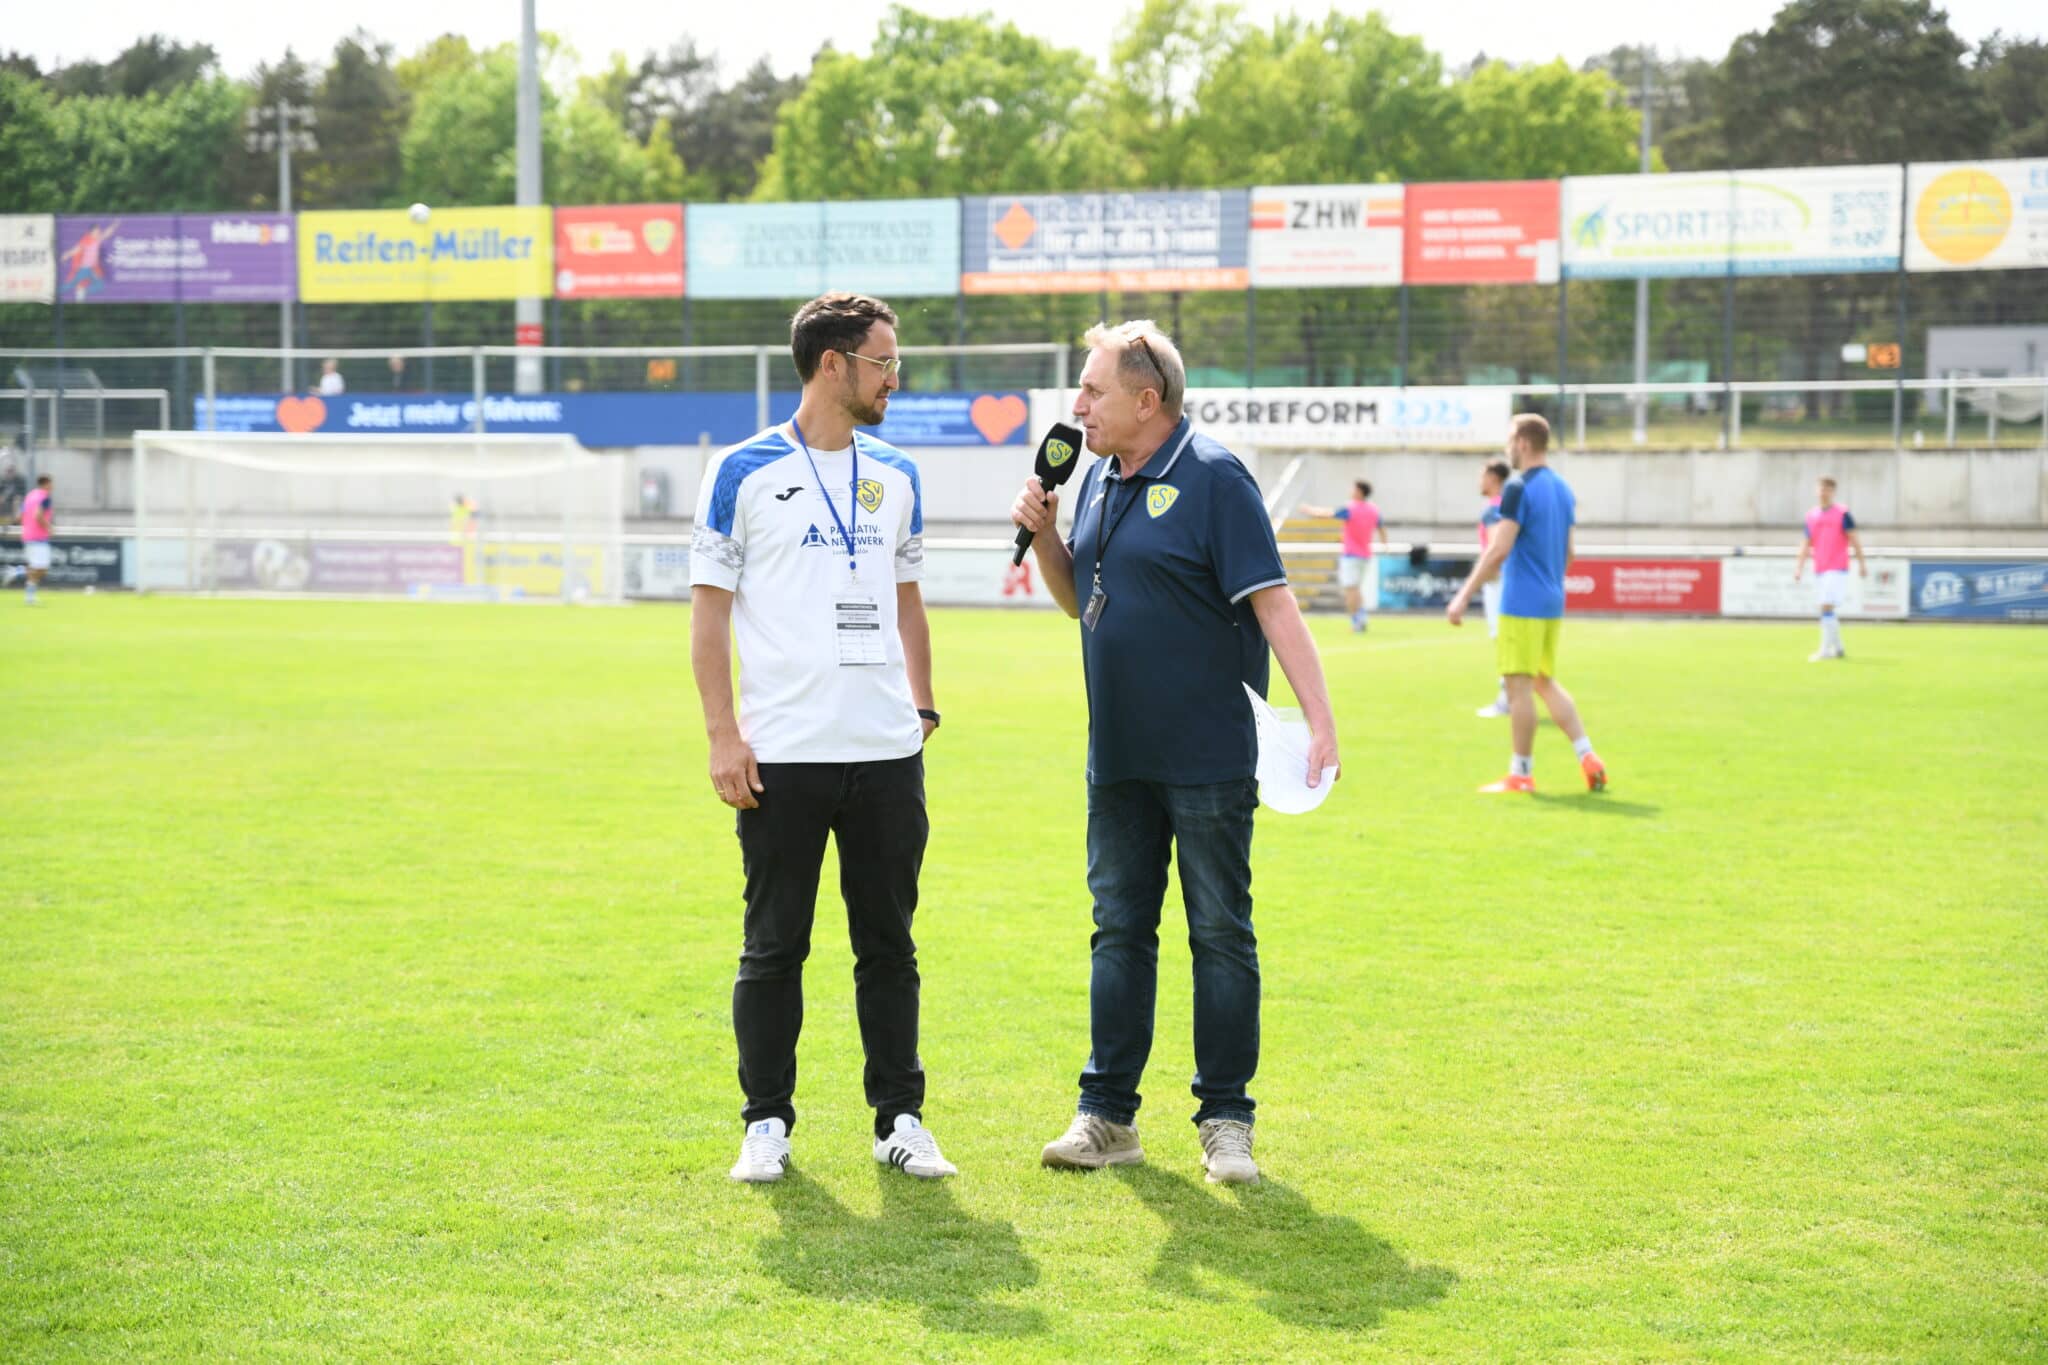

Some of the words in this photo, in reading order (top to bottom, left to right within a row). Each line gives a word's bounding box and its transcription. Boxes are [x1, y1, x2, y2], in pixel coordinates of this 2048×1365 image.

[1292, 200, 1361, 229] ZHW
[1615, 208, 1786, 240] SPORTPARK
[314, 230, 534, 264] Reifen-Müller
[347, 402, 401, 427] Jetzt
[403, 400, 460, 424] mehr
[1393, 399, 1472, 426] 2025
